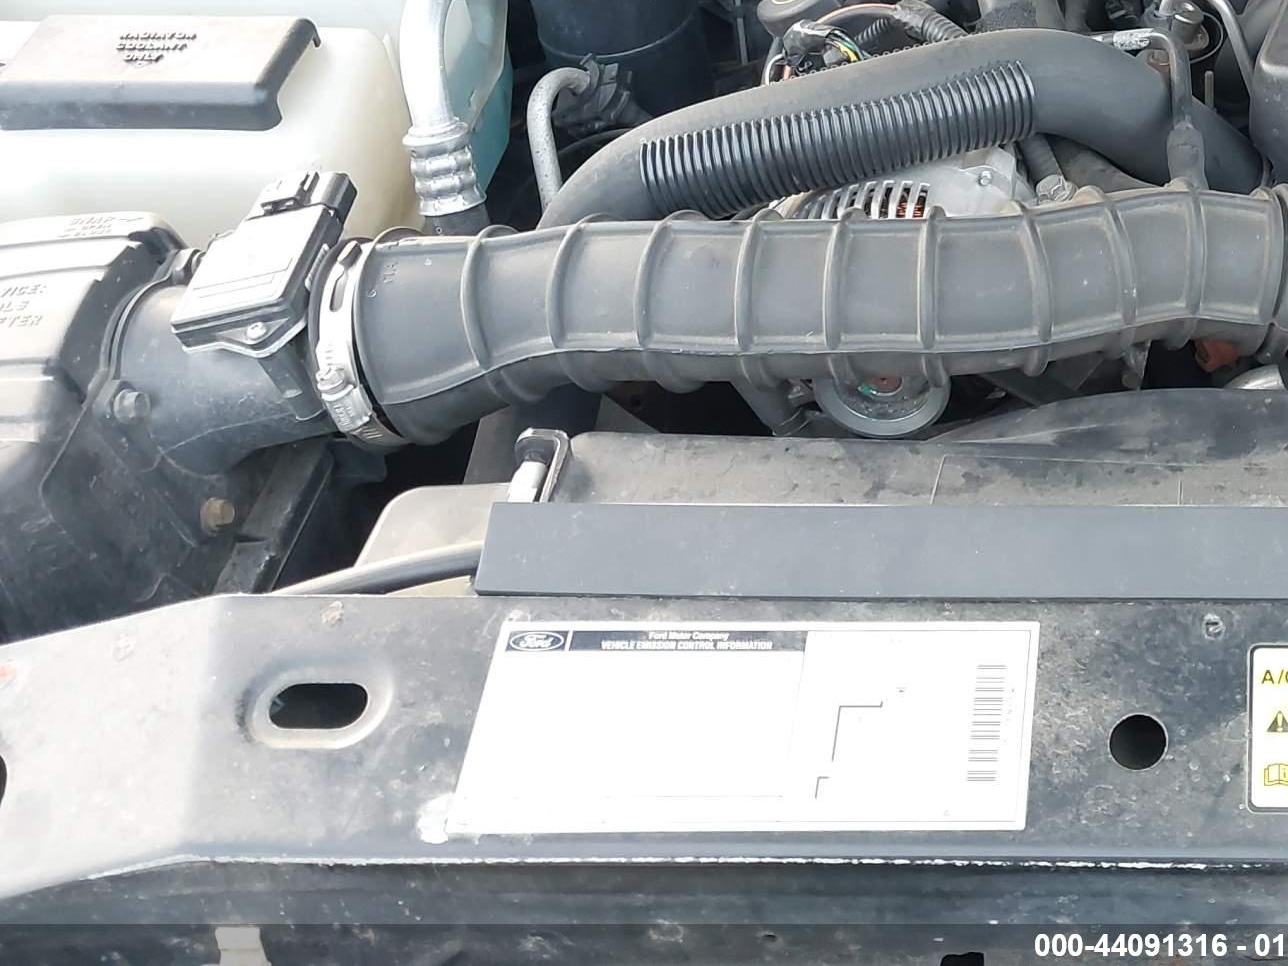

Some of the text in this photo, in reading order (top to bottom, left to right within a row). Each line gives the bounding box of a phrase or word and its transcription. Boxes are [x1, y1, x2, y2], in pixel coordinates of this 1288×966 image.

[692, 632, 729, 642] Company
[600, 640, 772, 650] VEHICLE EMISSION CONTROL INFORMATION
